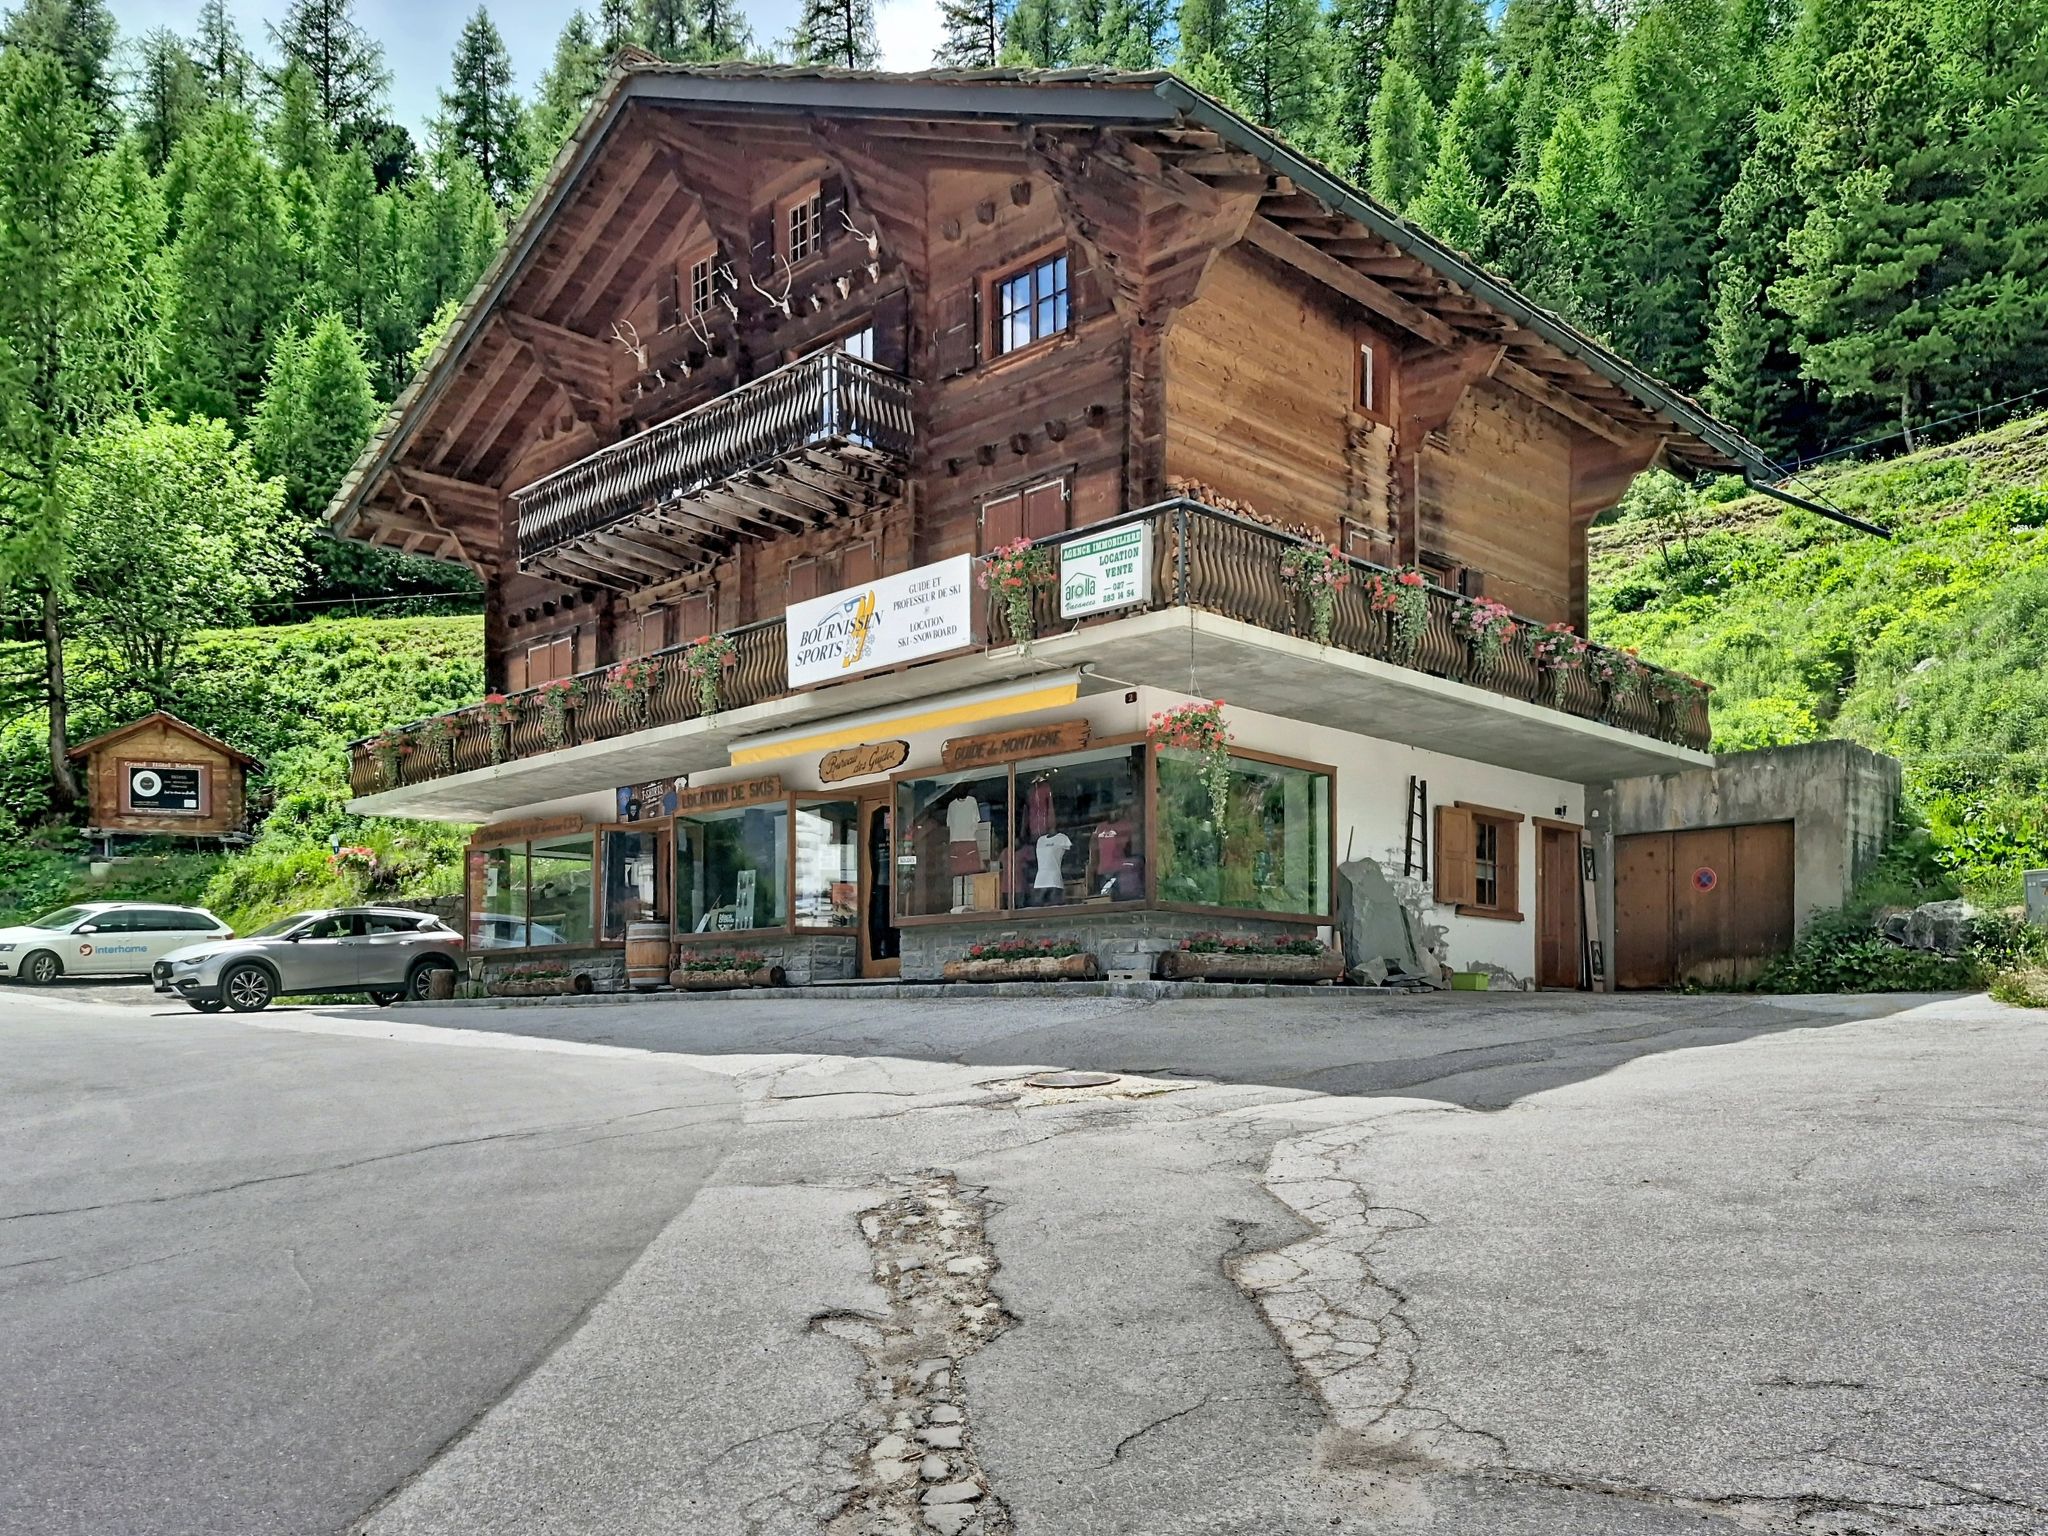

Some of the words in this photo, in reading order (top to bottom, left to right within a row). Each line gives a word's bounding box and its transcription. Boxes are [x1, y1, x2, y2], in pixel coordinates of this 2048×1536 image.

[1063, 544, 1091, 560] AGENCE
[1099, 547, 1139, 566] LOCATION
[1105, 563, 1133, 578] VENTE
[909, 579, 930, 594] GUIDE
[932, 577, 942, 588] ET
[1065, 578, 1096, 601] arolla
[1112, 581, 1125, 591] 027
[893, 590, 936, 611] PROFESSEUR
[938, 588, 948, 599] DE
[949, 584, 961, 596] SKI
[1065, 600, 1096, 611] Vacances
[800, 610, 884, 647] BOURNISSEN
[909, 615, 944, 632] LOCATION
[898, 636, 910, 648] SKI
[795, 641, 843, 667] SPORTS
[955, 742, 987, 760] GUIDE
[1000, 729, 1061, 754] MONTAGNE
[826, 755, 858, 775] Bureau
[853, 760, 867, 773] des
[682, 787, 728, 809] LOCATION
[731, 784, 745, 801] DE
[749, 779, 774, 798] SKIS
[95, 945, 148, 954] interhome
